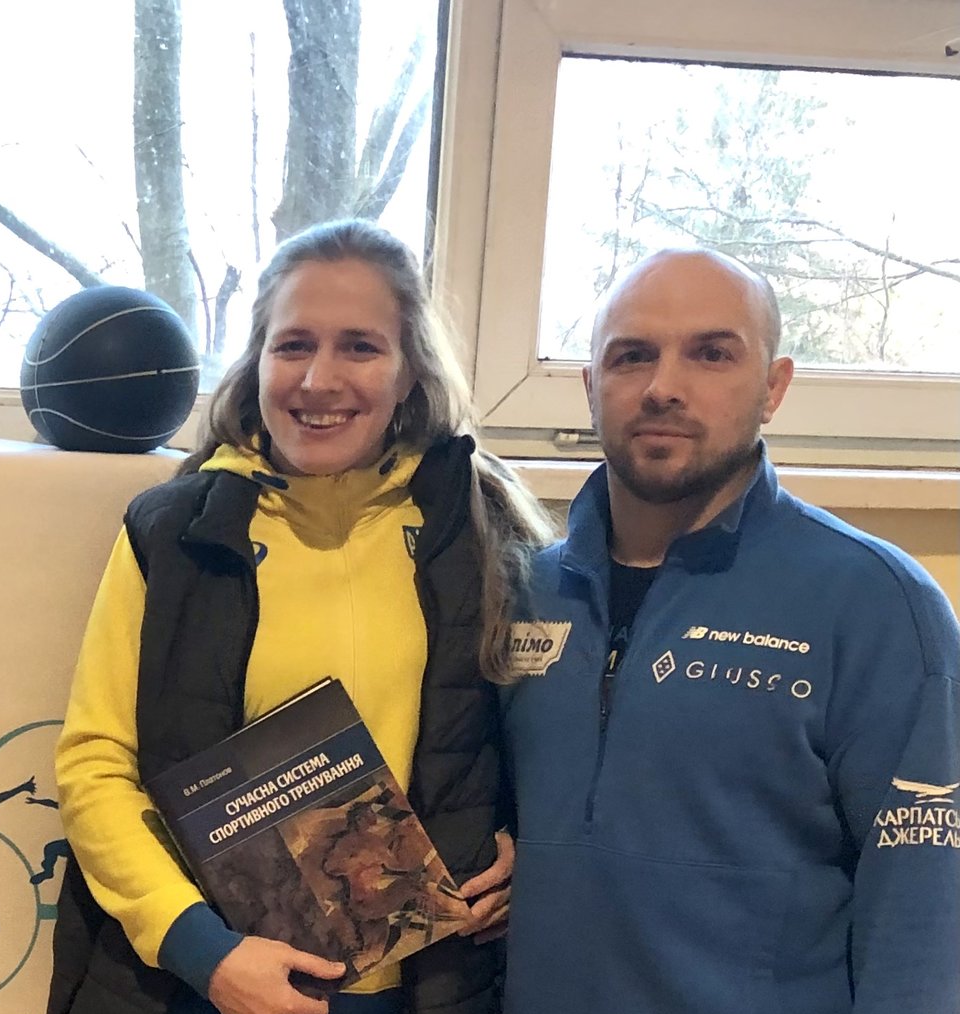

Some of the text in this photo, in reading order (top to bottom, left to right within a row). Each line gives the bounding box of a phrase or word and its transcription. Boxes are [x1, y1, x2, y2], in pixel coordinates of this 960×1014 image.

[708, 630, 741, 642] new
[742, 631, 811, 654] balance
[208, 753, 365, 845] СПОРТИВНОГО ТРЕНУВАННЯ
[225, 752, 331, 816] СУЧАСНА СИСТЕМА
